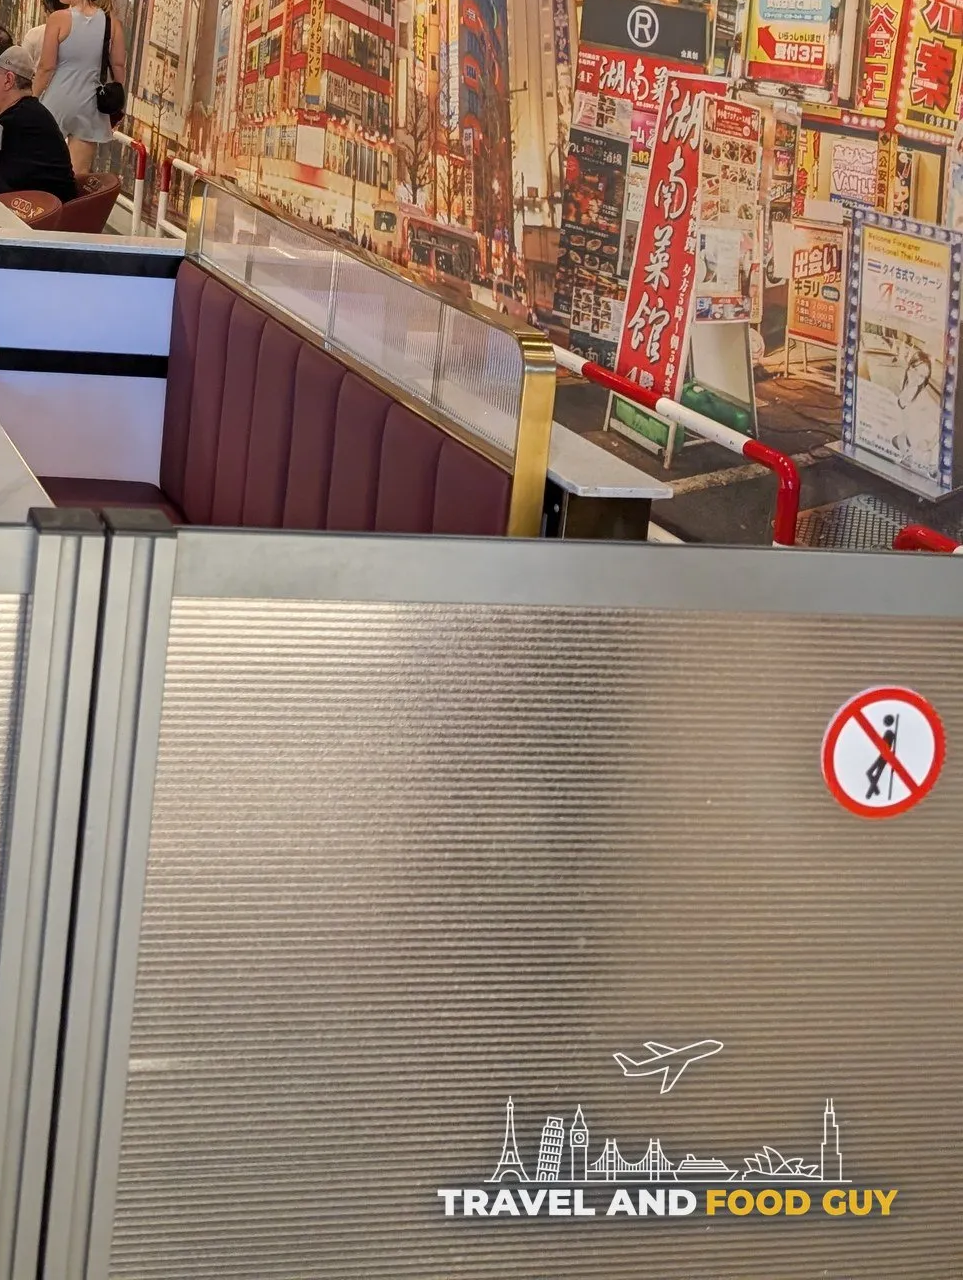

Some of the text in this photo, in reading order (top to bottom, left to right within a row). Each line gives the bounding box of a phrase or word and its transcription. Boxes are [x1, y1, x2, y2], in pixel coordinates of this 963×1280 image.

[775, 42, 824, 61] 受付3F
[577, 70, 595, 84] 4F
[794, 280, 820, 298] キラリ
